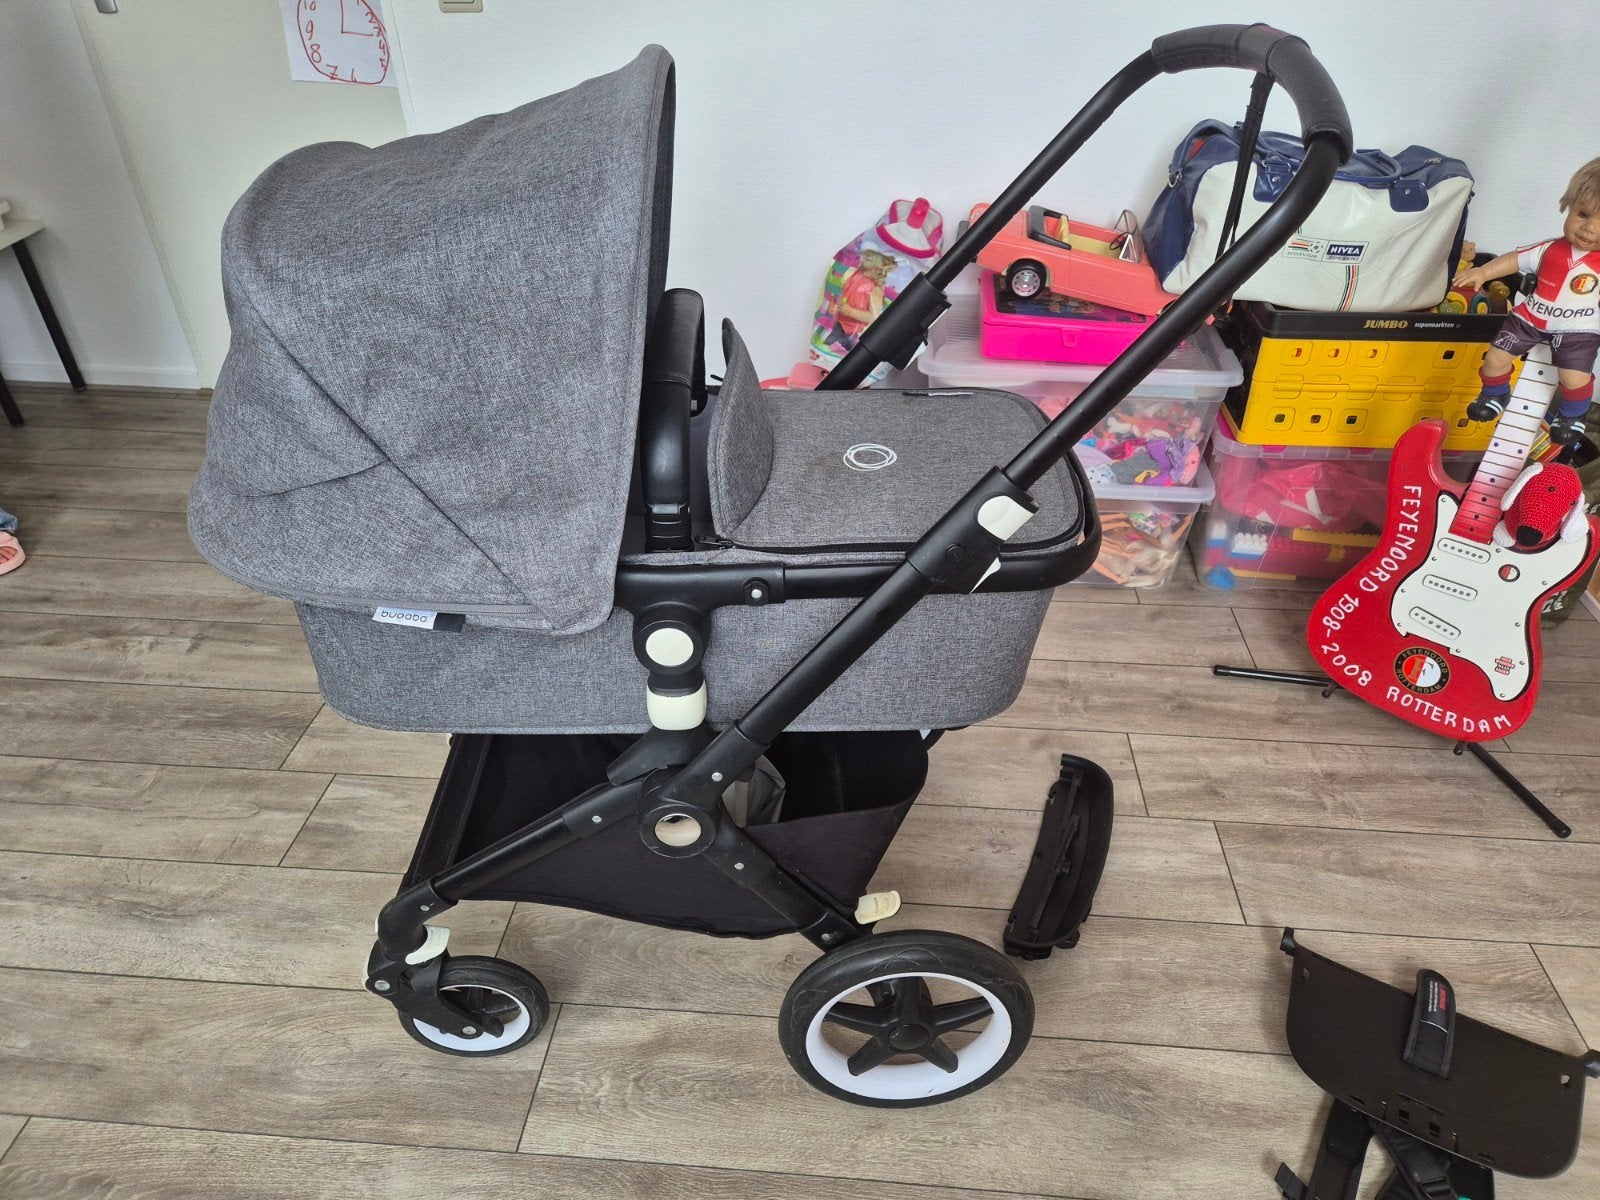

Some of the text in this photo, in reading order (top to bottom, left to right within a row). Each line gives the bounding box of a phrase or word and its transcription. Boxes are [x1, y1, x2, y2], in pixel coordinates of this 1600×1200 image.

[304, 0, 317, 11] 10
[365, 11, 376, 24] 2
[305, 20, 314, 41] 9
[373, 26, 382, 37] 3
[310, 43, 322, 64] 8
[378, 39, 386, 56] 4
[326, 64, 338, 80] 7
[379, 58, 387, 72] 5
[351, 68, 357, 83] 6
[1330, 246, 1360, 255] NIVEA
[1527, 293, 1595, 318] EYENOORD
[1363, 319, 1409, 329] JUMBO
[1414, 321, 1455, 329] supermarkten
[1359, 485, 1422, 592] FEYENOORD
[1402, 648, 1448, 673] FEYENOORD
[1386, 686, 1512, 733] ROTTERDAM
